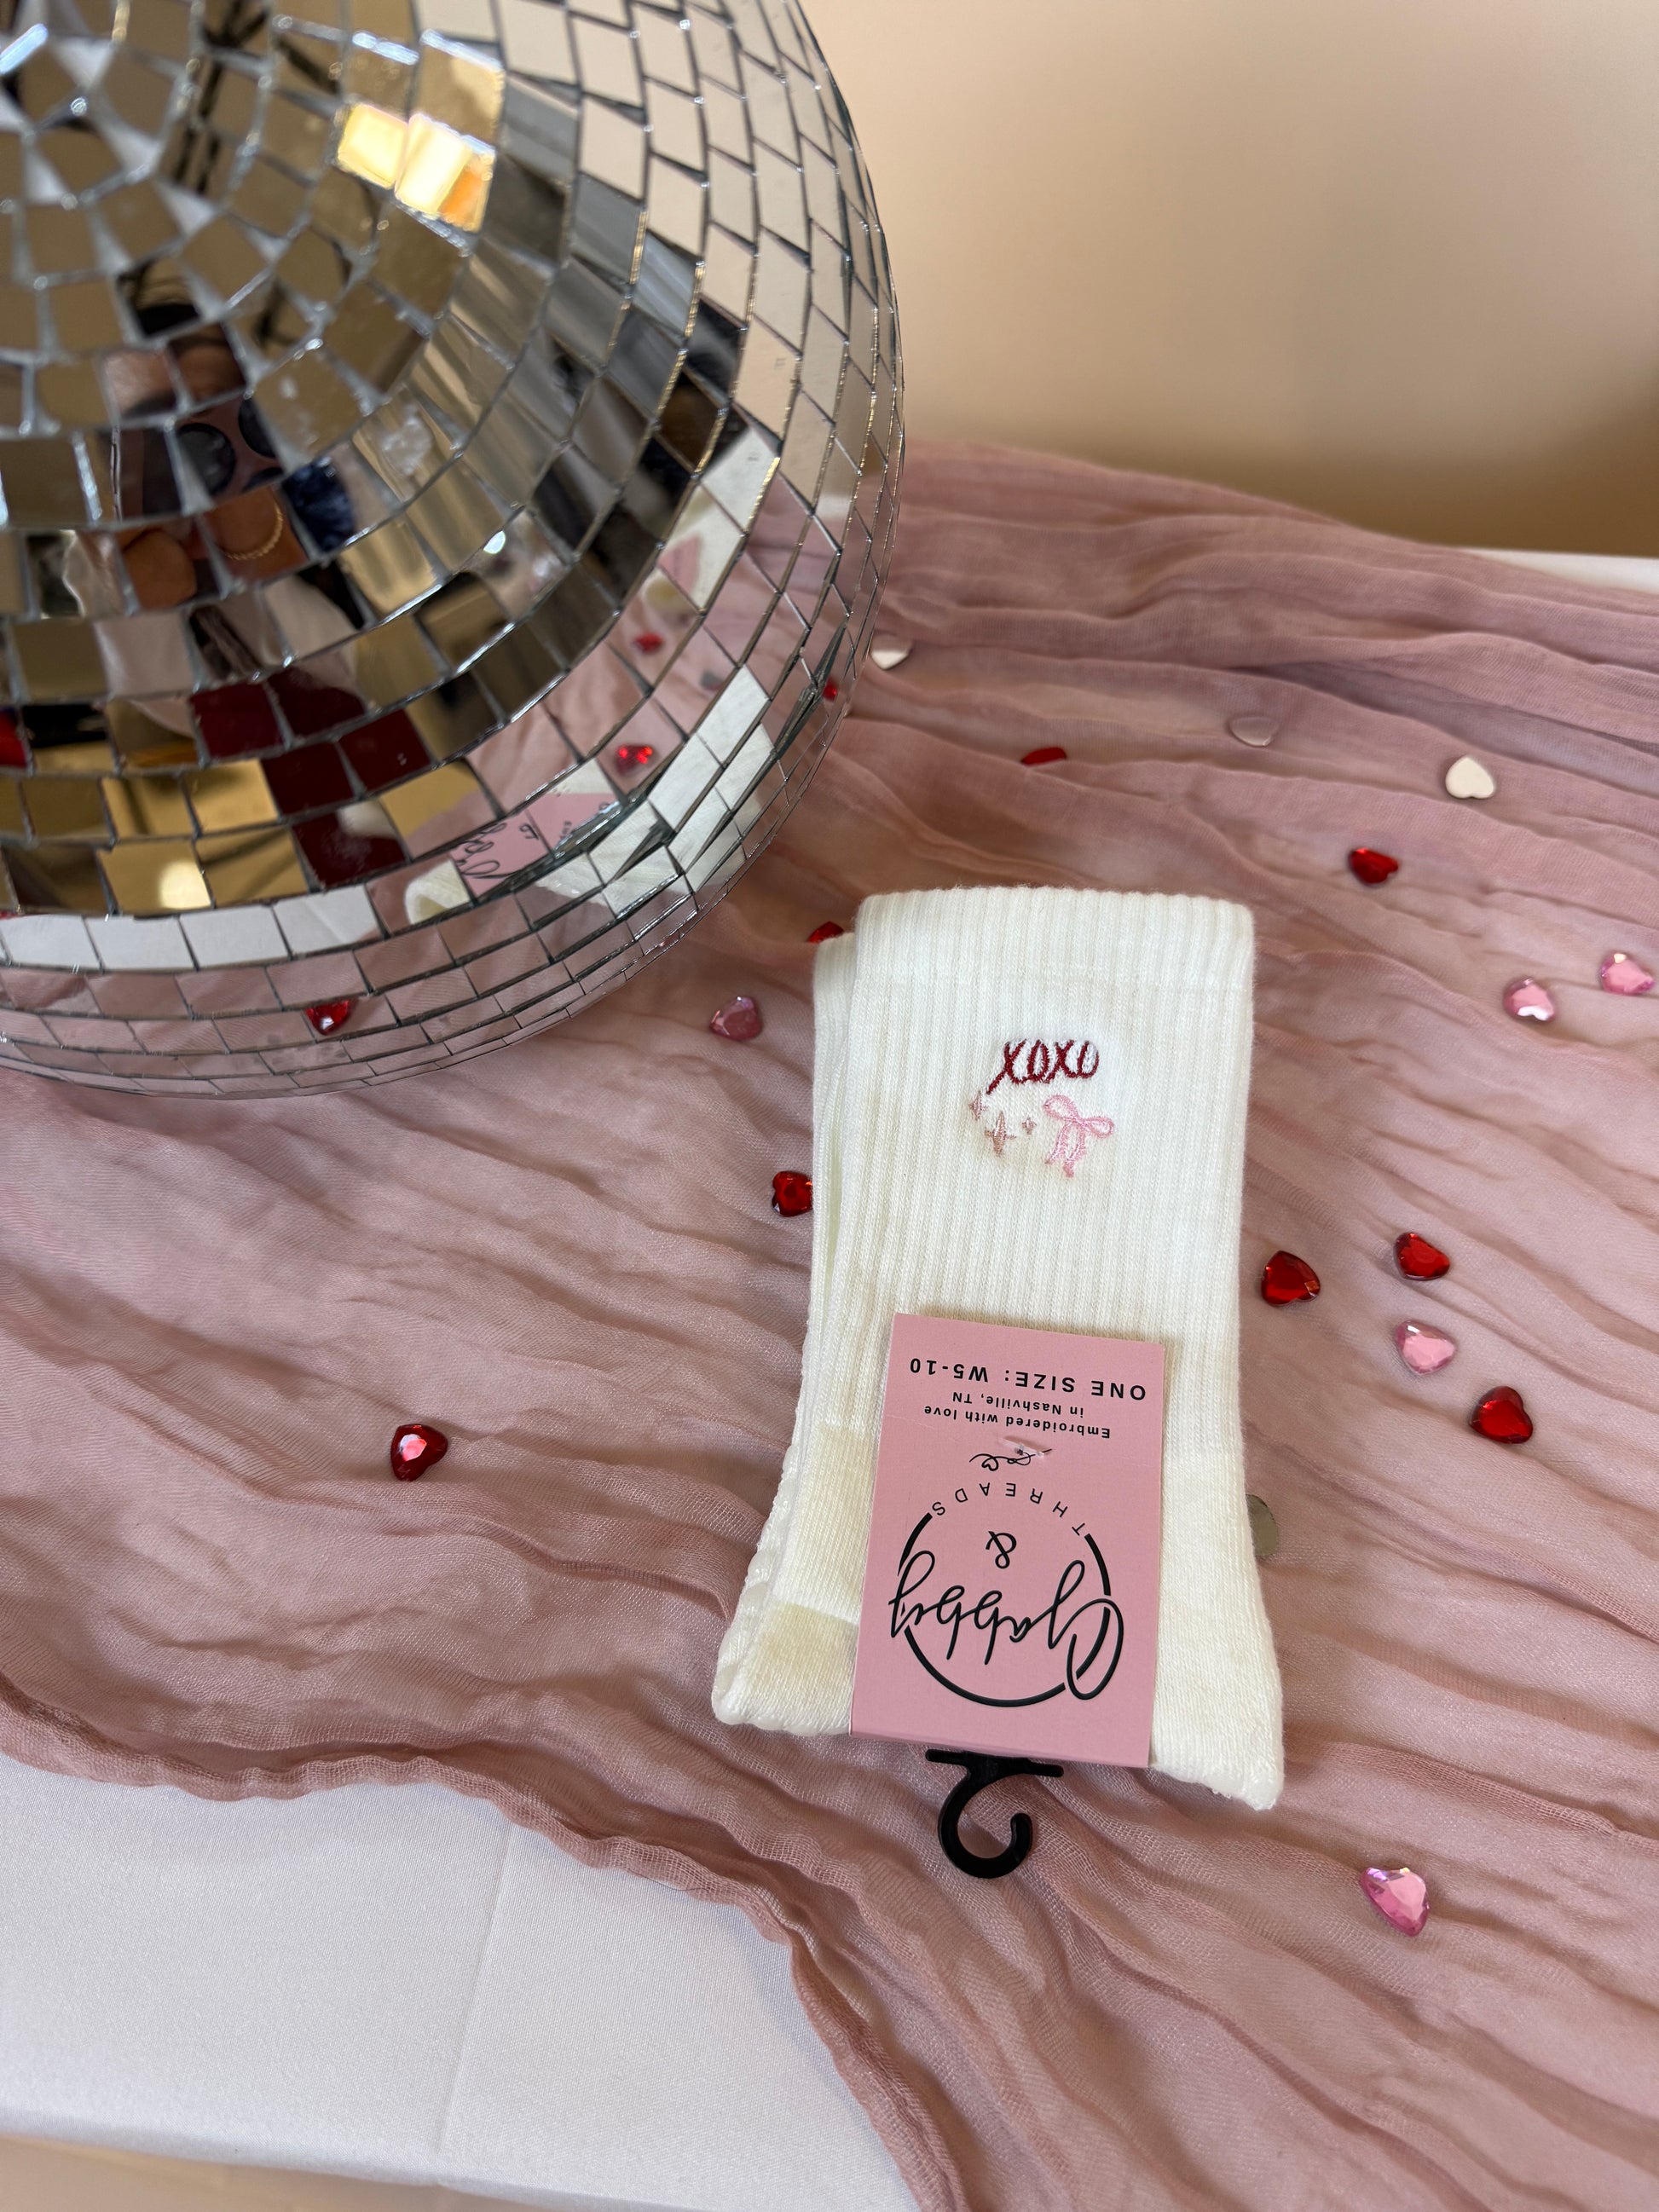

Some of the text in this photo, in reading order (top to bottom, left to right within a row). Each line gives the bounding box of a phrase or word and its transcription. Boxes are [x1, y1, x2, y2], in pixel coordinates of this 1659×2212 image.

[910, 1358, 1147, 1401] ONE SIZE: W5-10
[924, 1405, 1111, 1439] Embroidered with love
[952, 1391, 1084, 1418] in Nashville, TN
[932, 1482, 1085, 1536] THREADS
[985, 1531, 1017, 1569] &
[888, 1550, 1124, 1701] Gabby
